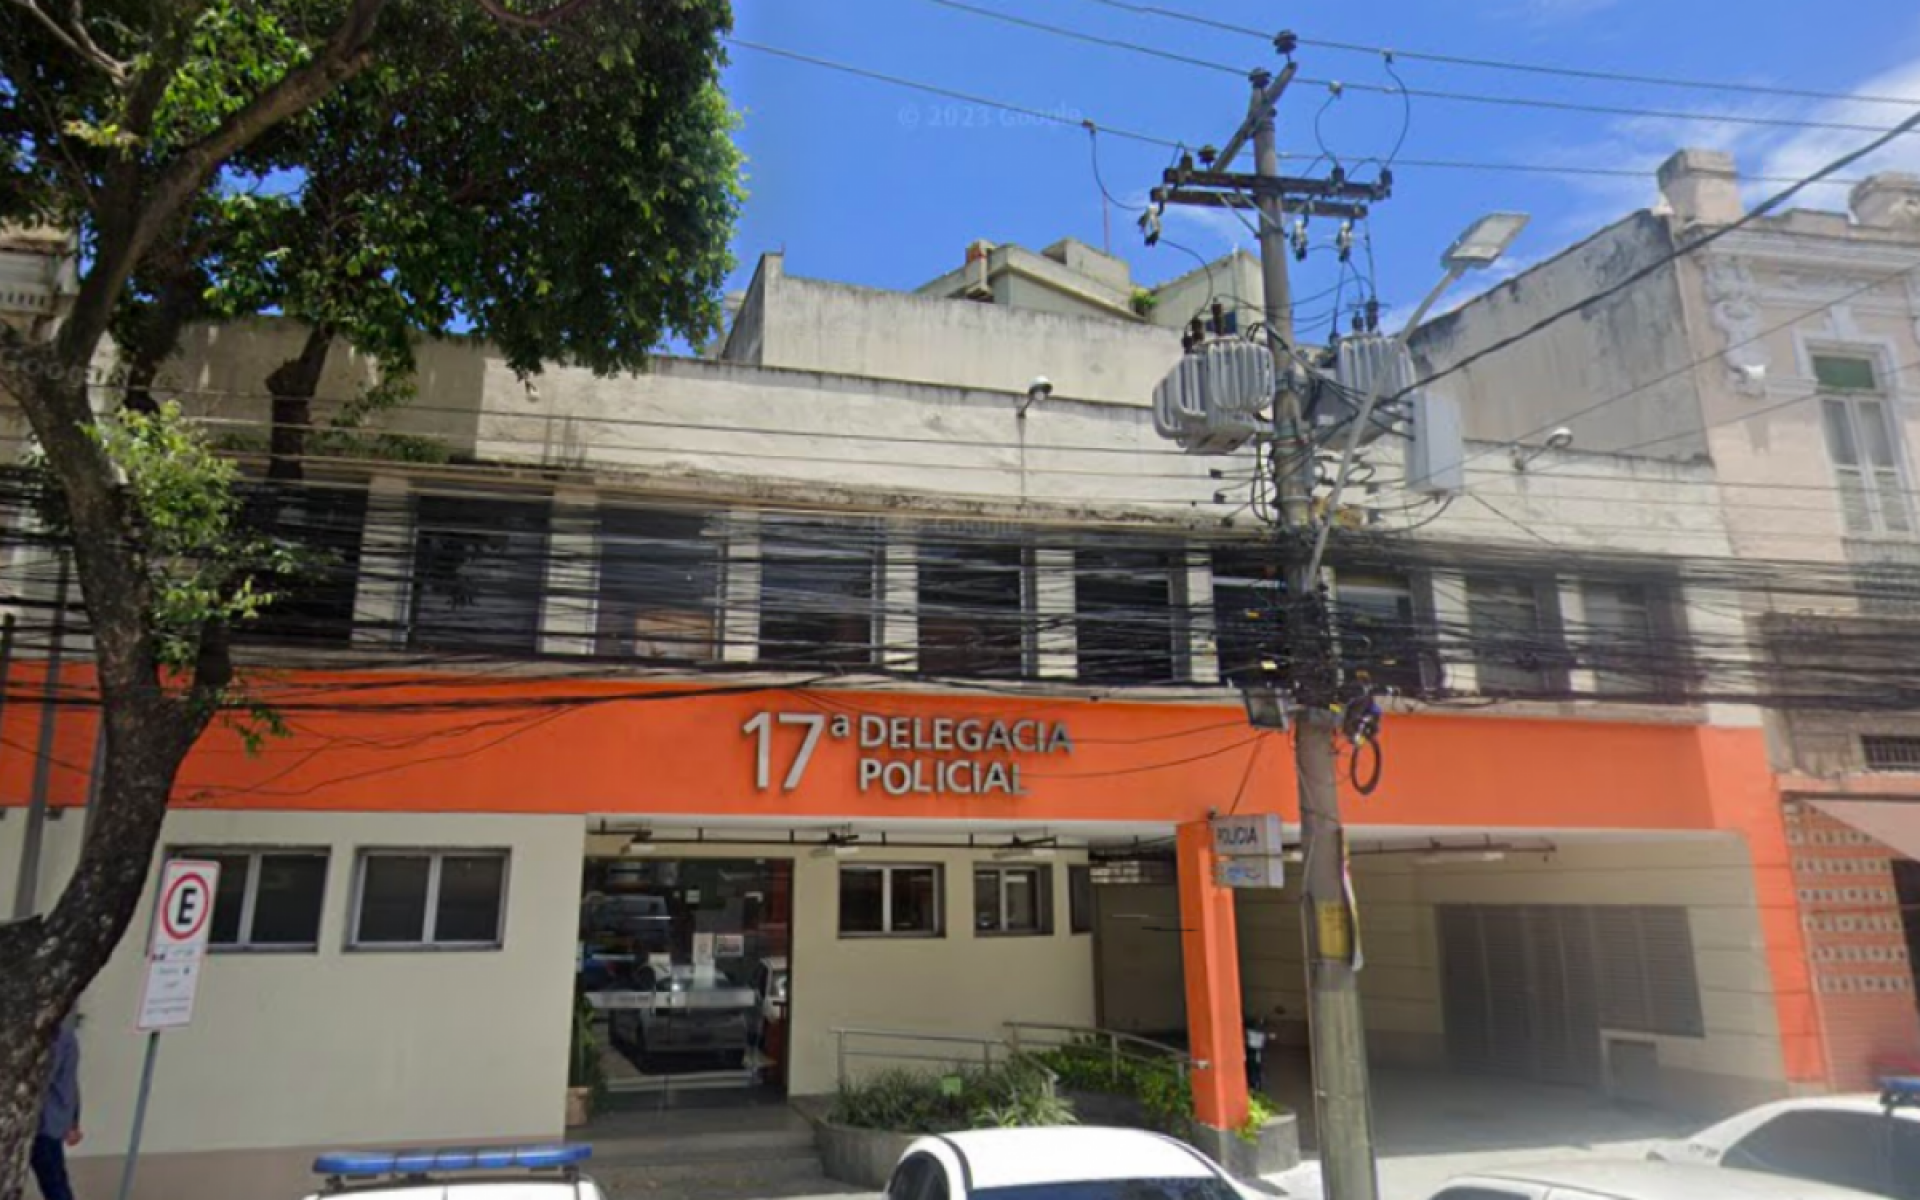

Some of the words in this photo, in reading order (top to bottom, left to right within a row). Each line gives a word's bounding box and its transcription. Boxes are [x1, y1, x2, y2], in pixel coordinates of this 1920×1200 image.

[859, 714, 1074, 754] DELEGACIA
[859, 758, 1031, 796] POLICIAL
[175, 887, 198, 926] E
